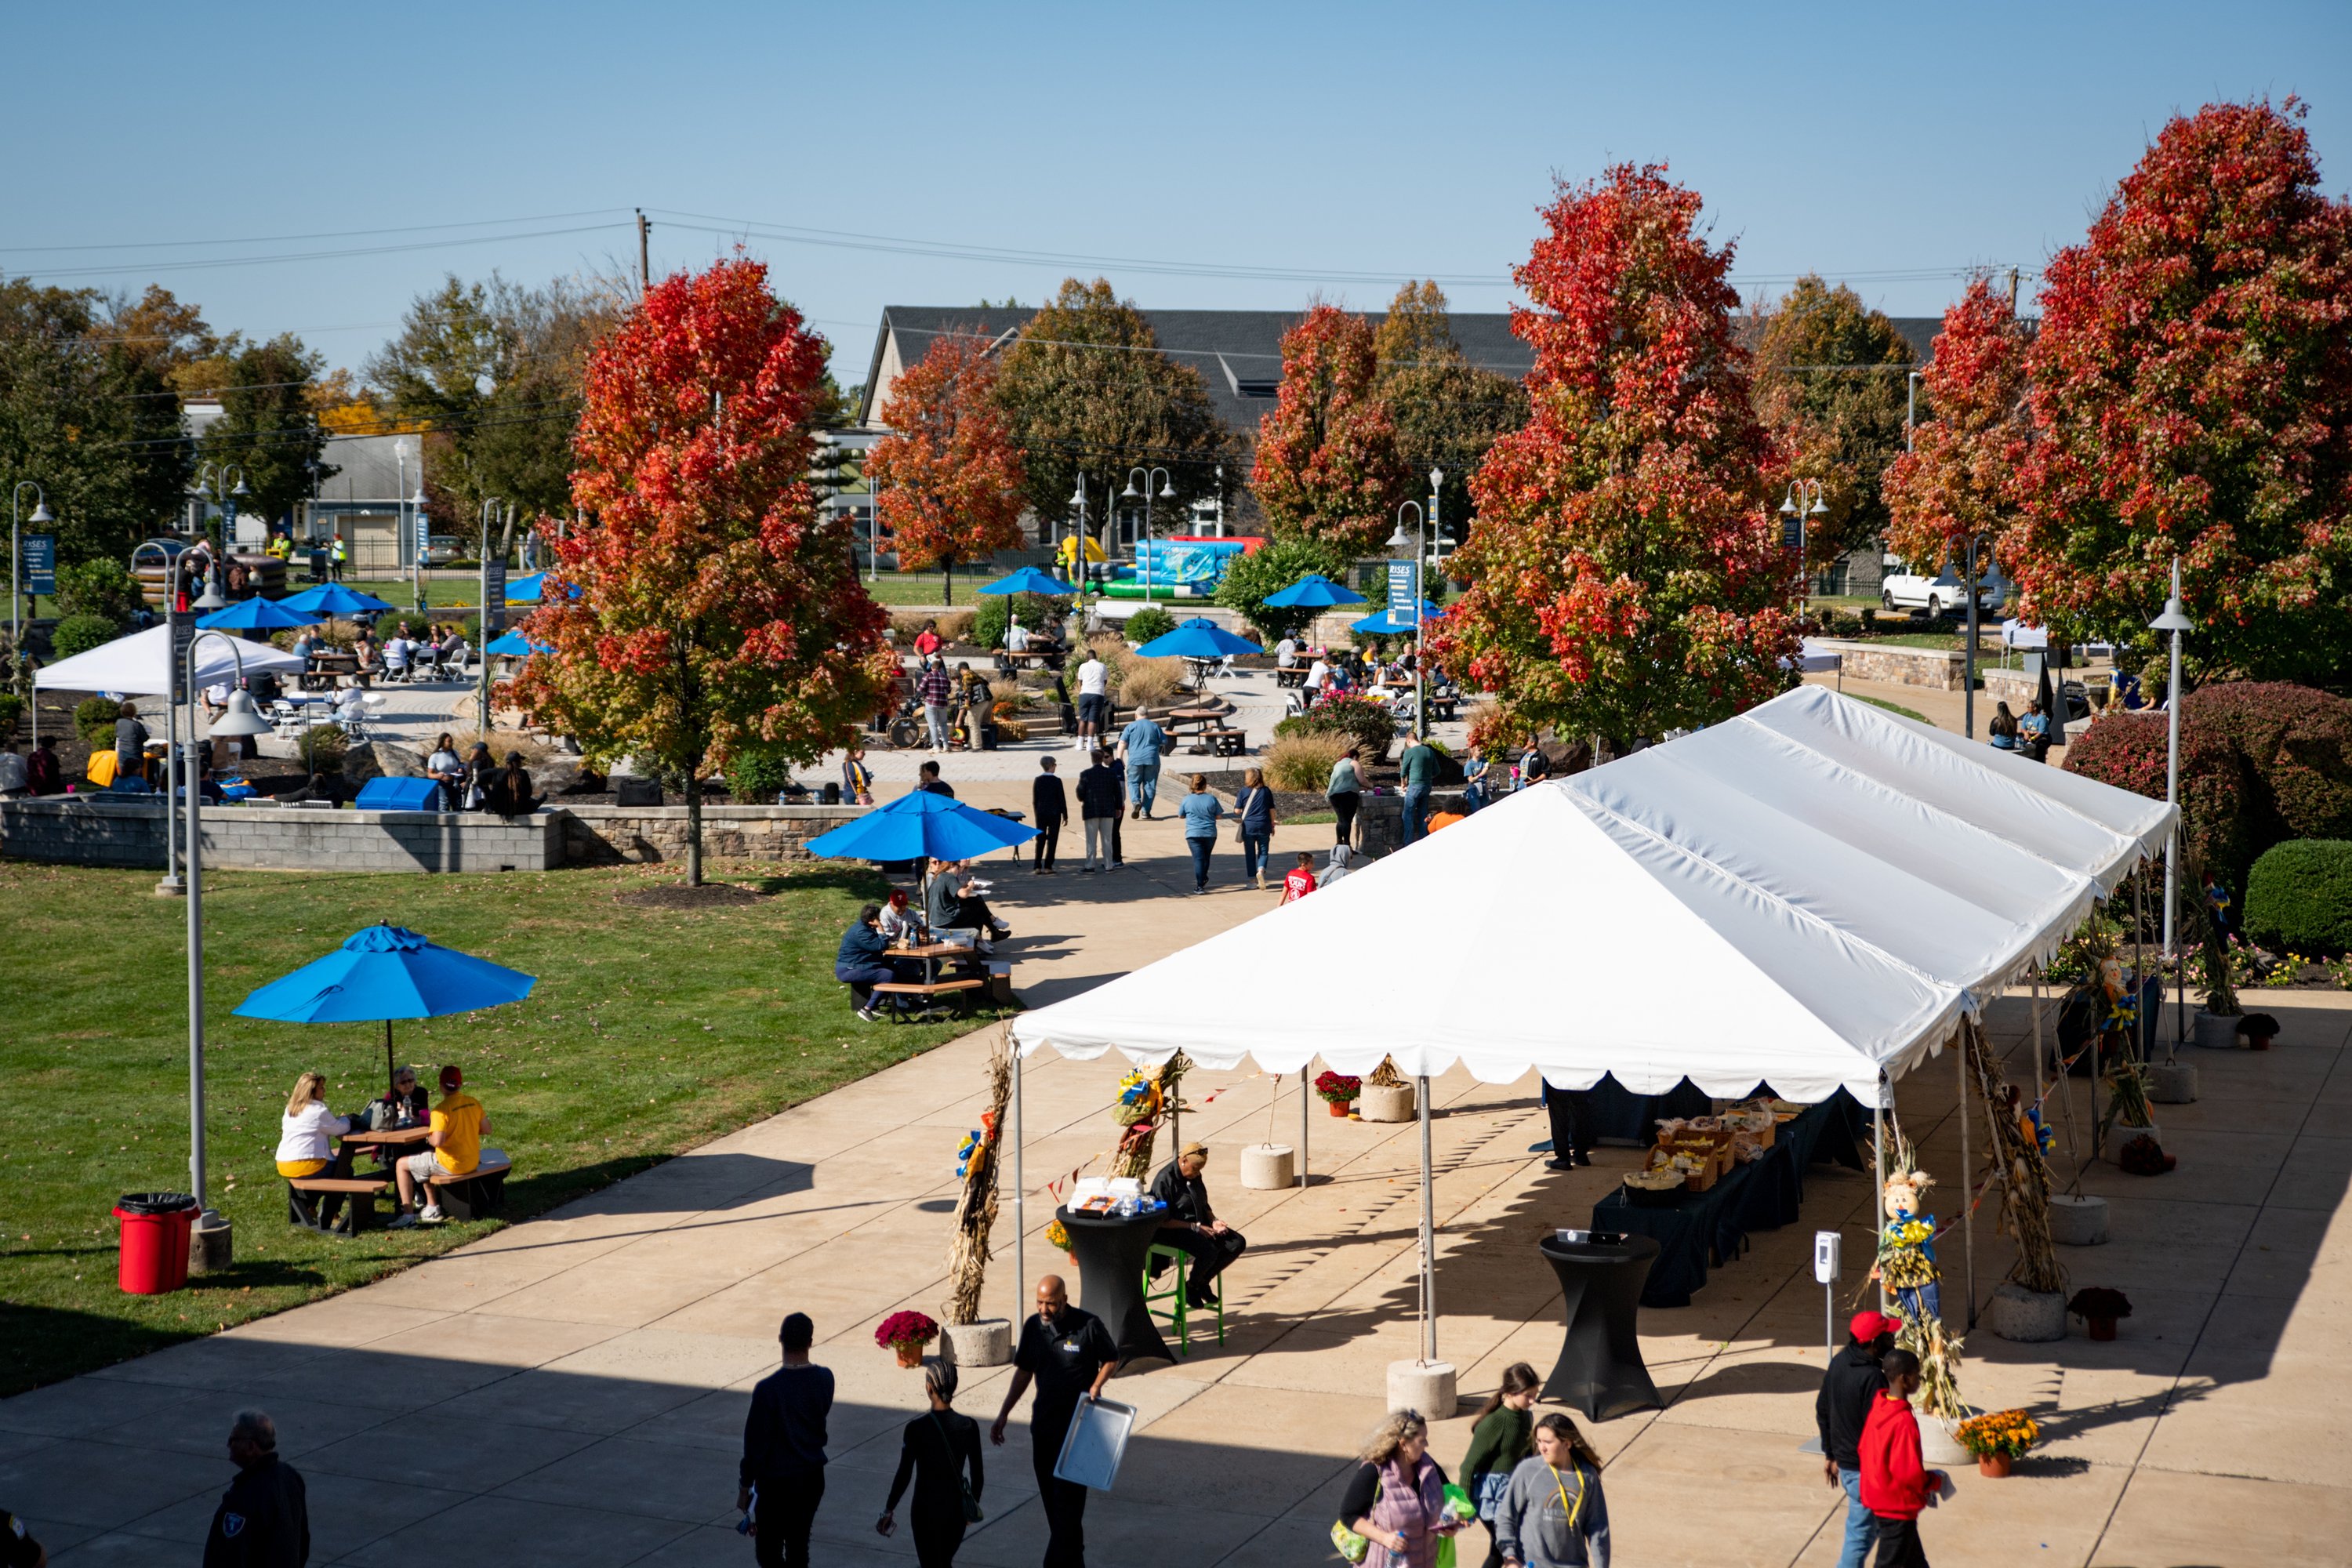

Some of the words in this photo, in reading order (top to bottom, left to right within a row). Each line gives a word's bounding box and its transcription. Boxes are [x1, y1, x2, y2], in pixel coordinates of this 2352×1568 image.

[23, 539, 47, 548] RISES
[489, 566, 503, 575] RISES
[1389, 565, 1410, 574] RISES
[176, 626, 191, 635] RISES
